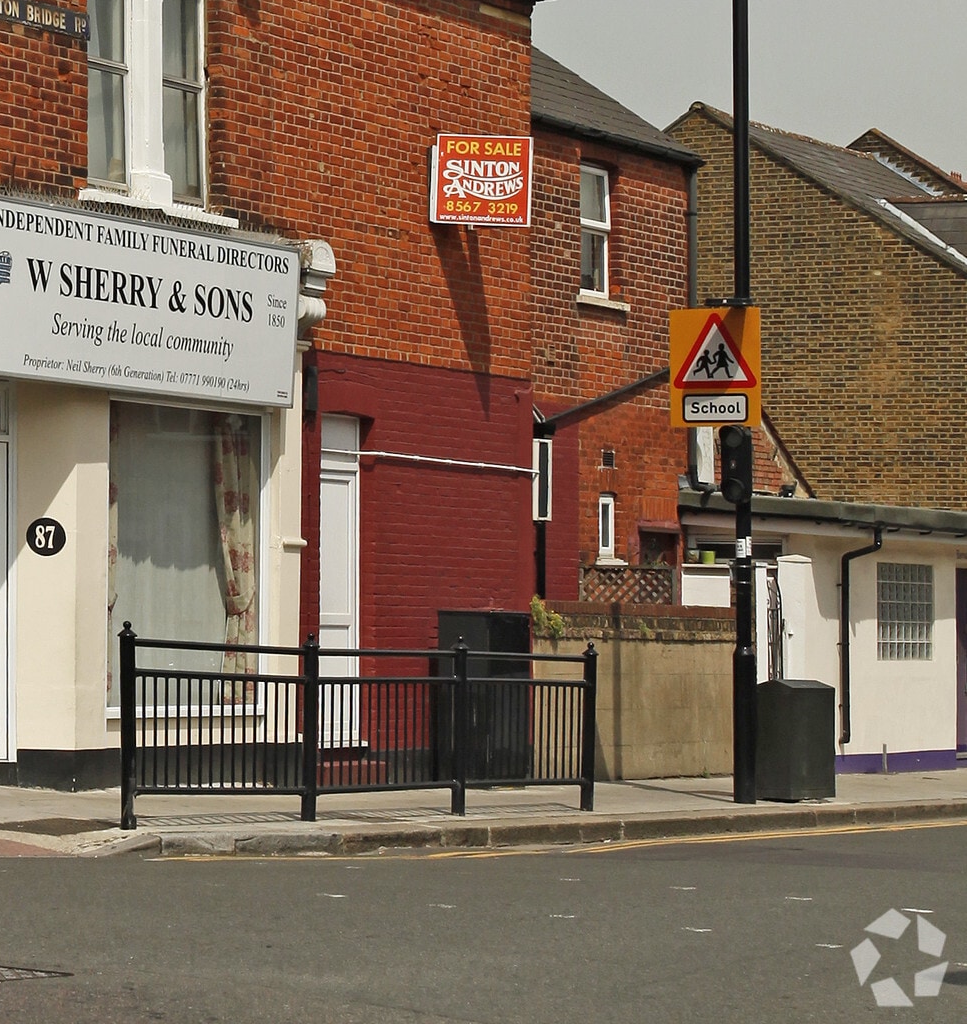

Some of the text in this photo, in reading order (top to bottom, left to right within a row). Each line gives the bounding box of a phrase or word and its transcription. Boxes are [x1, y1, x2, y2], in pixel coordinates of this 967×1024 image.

[26, 4, 66, 30] BRIDGE
[446, 140, 522, 156] FOR SALE
[443, 159, 521, 180] SINTON
[443, 177, 524, 199] ANDREWS
[446, 200, 518, 214] 8567 3219
[439, 214, 524, 223] www.sintonandrews.co.uk
[97, 225, 149, 251] FAMILY
[152, 235, 214, 262] FUNERAL
[217, 246, 289, 275] DIRECTORS
[26, 257, 253, 323] W SHERRY & SONS
[266, 293, 287, 310] Since
[267, 314, 285, 329] 1850
[51, 312, 234, 362] Serving the local community
[23, 353, 250, 393] Proprietor: Neil Sherry (6th Generation) Tel: 07771 990190 (24hrs)
[690, 402, 741, 414] School
[34, 525, 56, 549] 87
